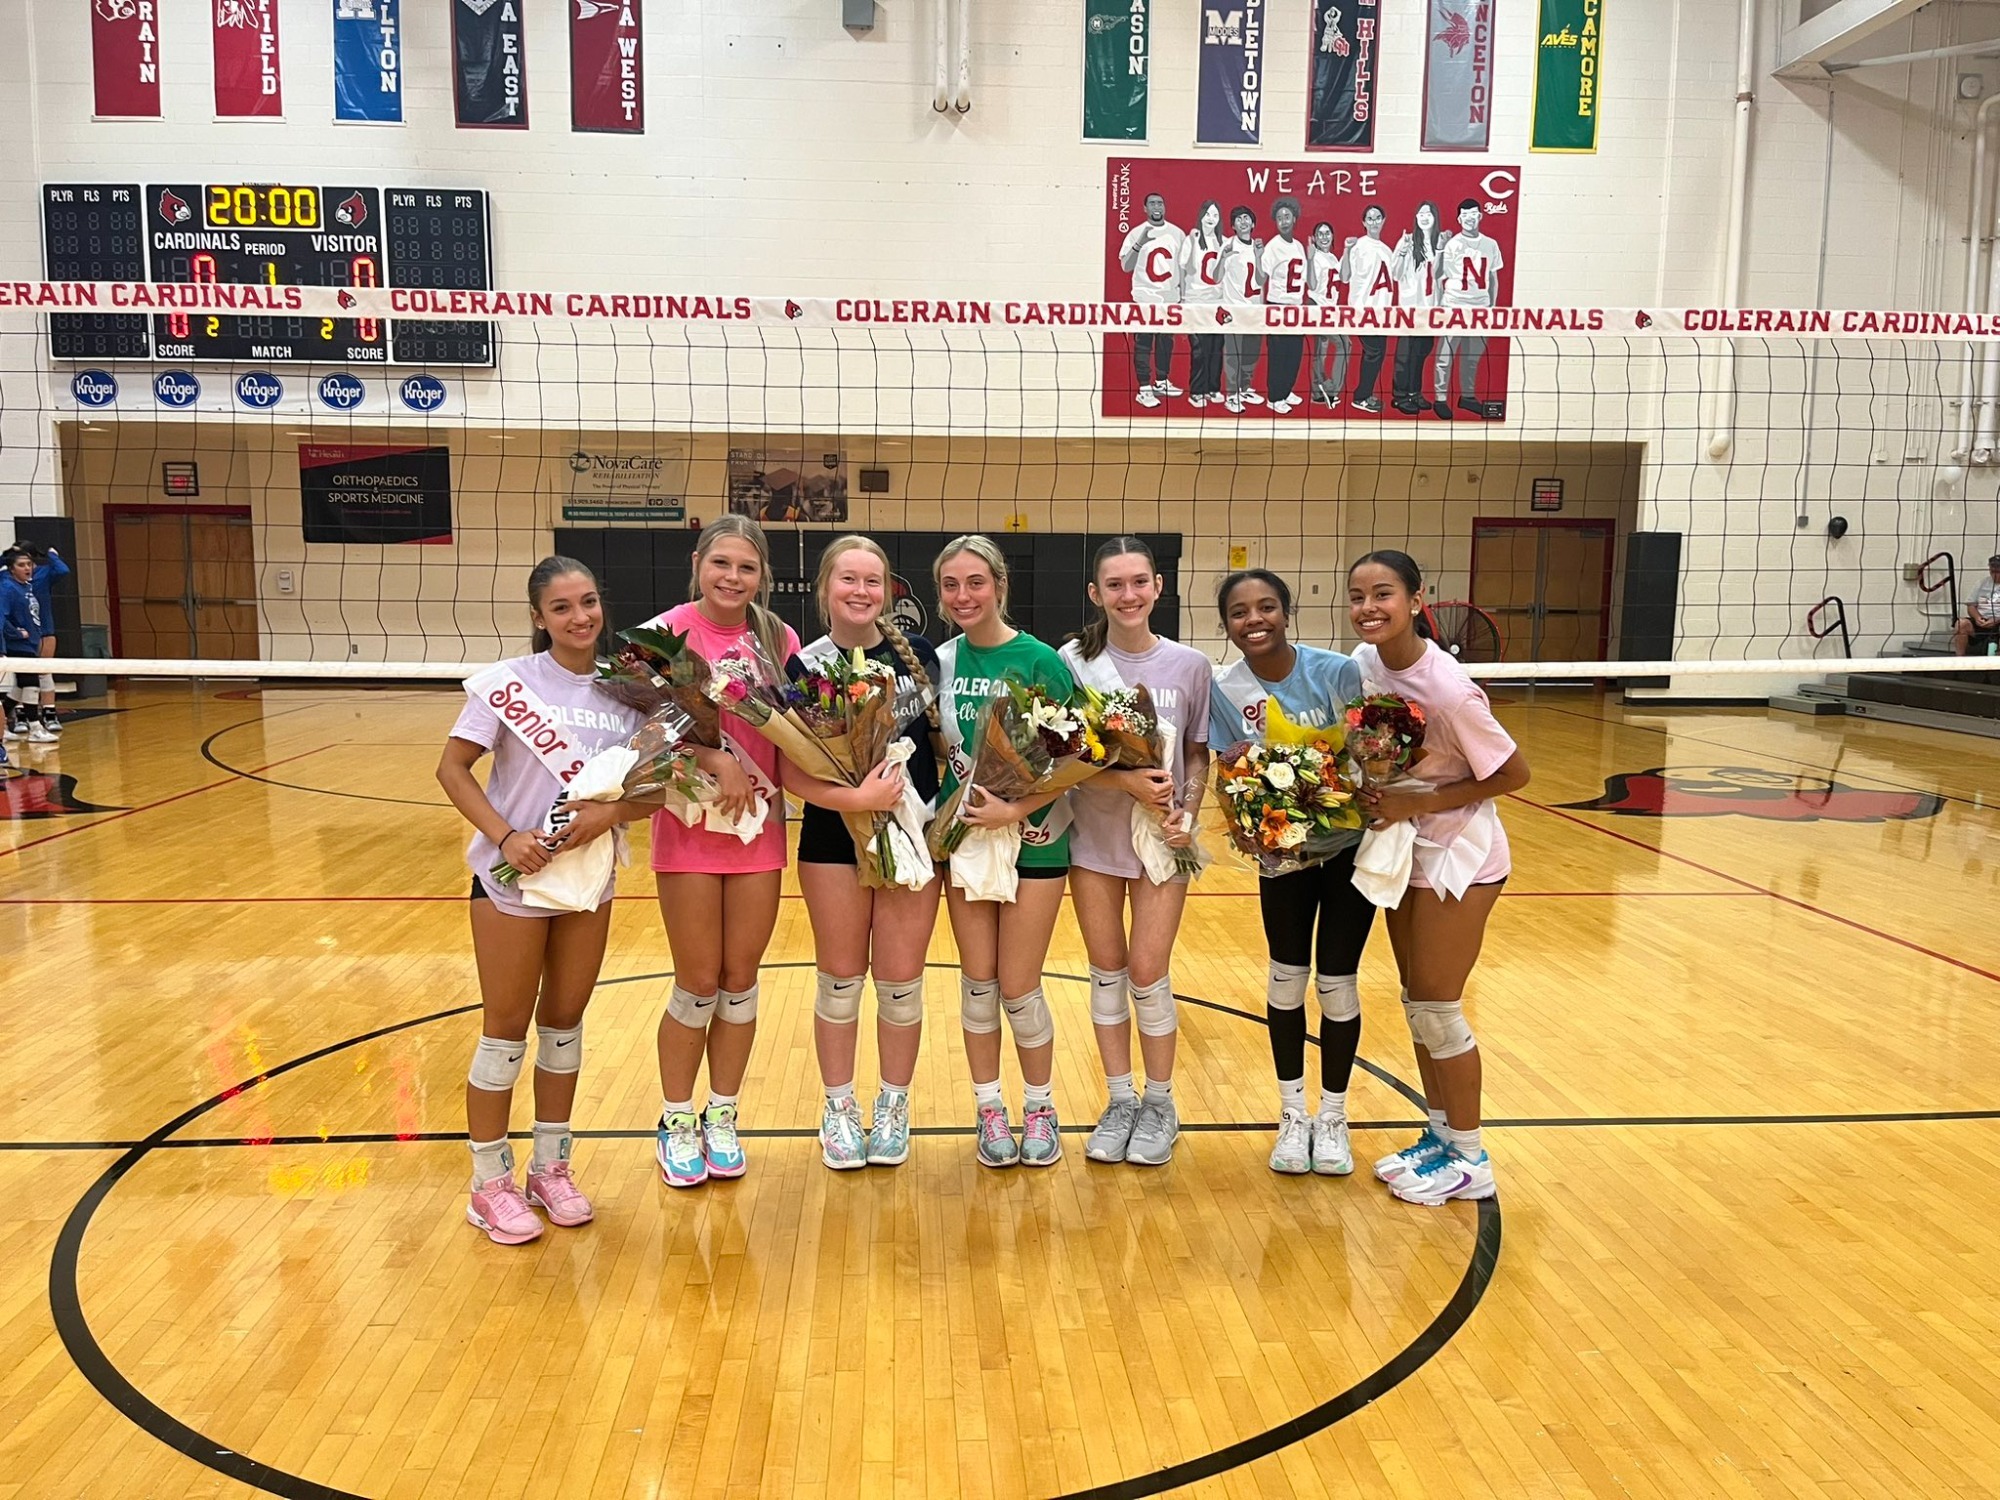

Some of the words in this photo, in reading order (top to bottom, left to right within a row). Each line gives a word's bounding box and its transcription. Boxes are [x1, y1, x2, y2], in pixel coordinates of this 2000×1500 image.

[618, 0, 636, 26] A
[138, 2, 155, 83] RAIN
[380, 0, 397, 92] LTON
[1353, 18, 1375, 122] HILLS
[1469, 0, 1489, 124] NCETON
[1578, 0, 1598, 116] CAMORE
[502, 34, 519, 117] EAST
[617, 38, 637, 121] WEST
[1247, 167, 1294, 194] WE
[1307, 169, 1379, 196] ARE
[51, 190, 73, 202] PLYR
[84, 190, 100, 202] FLS
[112, 190, 130, 202] PTS
[210, 187, 316, 226] 20:00
[392, 195, 415, 207] PLYR
[426, 195, 442, 207] FLS
[455, 196, 472, 208] PTS
[1484, 201, 1509, 214] Reds
[154, 232, 240, 250] CARDINALS
[245, 243, 286, 255] PERIOD
[311, 234, 378, 252] VISITOR
[111, 284, 302, 309] CARDINALS
[391, 289, 552, 315] COLERAIN
[566, 294, 751, 319] CARDINALS
[836, 299, 991, 324] COLERAIN
[1005, 302, 1183, 326] CARDINALS
[1265, 306, 1415, 329] COLERAIN
[1428, 308, 1604, 331] CARDINALS
[1684, 309, 1830, 332] COLERAIN
[1842, 311, 2000, 335] CARDINALS
[158, 345, 195, 356] SCORE
[252, 346, 292, 358] MATCH
[347, 347, 384, 359] SCORE
[76, 375, 114, 402] Kroger
[158, 375, 196, 403] Kroger
[241, 376, 279, 405] Kroger
[323, 378, 361, 406] Kroger
[404, 380, 442, 407] Kroger
[593, 455, 663, 470] NovaCare
[332, 475, 419, 487] ORTHOPAEDICS
[328, 493, 369, 503] SPORTS
[371, 493, 424, 504] MEDICINE
[489, 681, 568, 755] Senior
